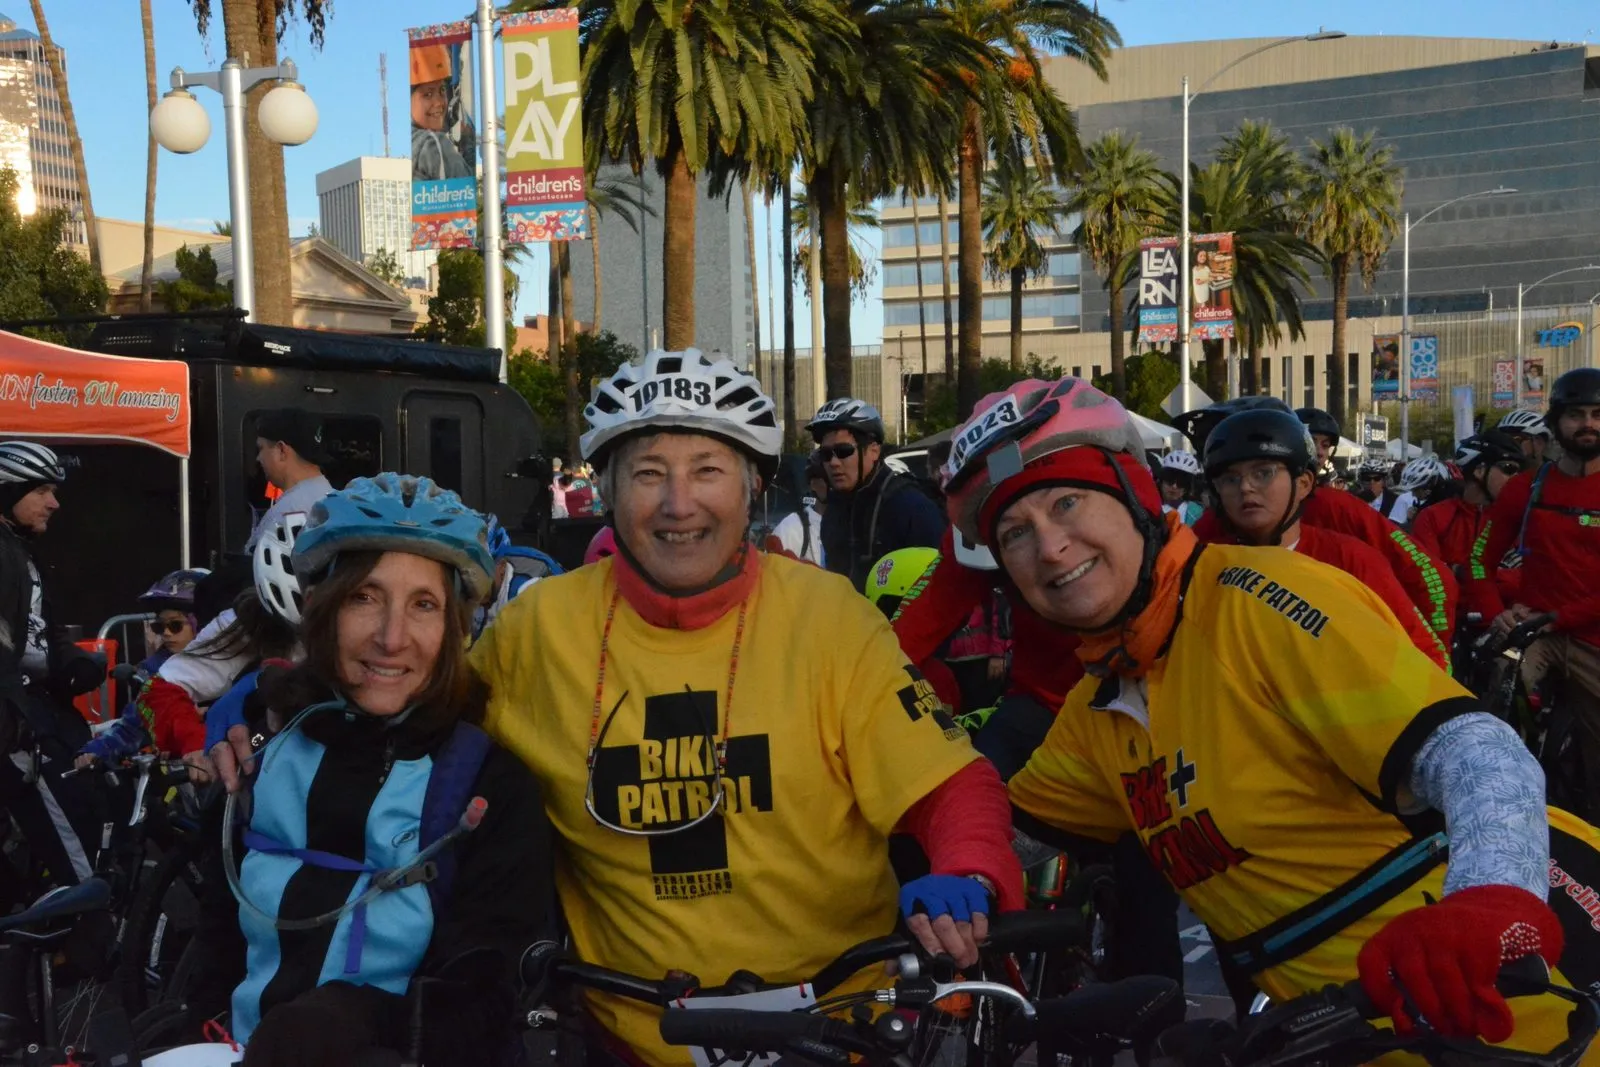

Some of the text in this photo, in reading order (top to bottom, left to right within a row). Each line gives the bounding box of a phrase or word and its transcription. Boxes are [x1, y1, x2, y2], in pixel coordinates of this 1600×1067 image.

[1142, 247, 1178, 277] LEA
[1140, 279, 1176, 305] RN
[1537, 327, 1581, 348] TEP
[31, 373, 78, 409] faster,
[84, 380, 118, 405] DU
[117, 388, 181, 422] amazing
[629, 377, 711, 412] 10183
[953, 400, 1017, 471] 10023
[1256, 581, 1330, 638] PATROL
[617, 775, 758, 829] PATROL
[653, 871, 731, 884] PERIMETER
[654, 882, 732, 896] BICYCLING
